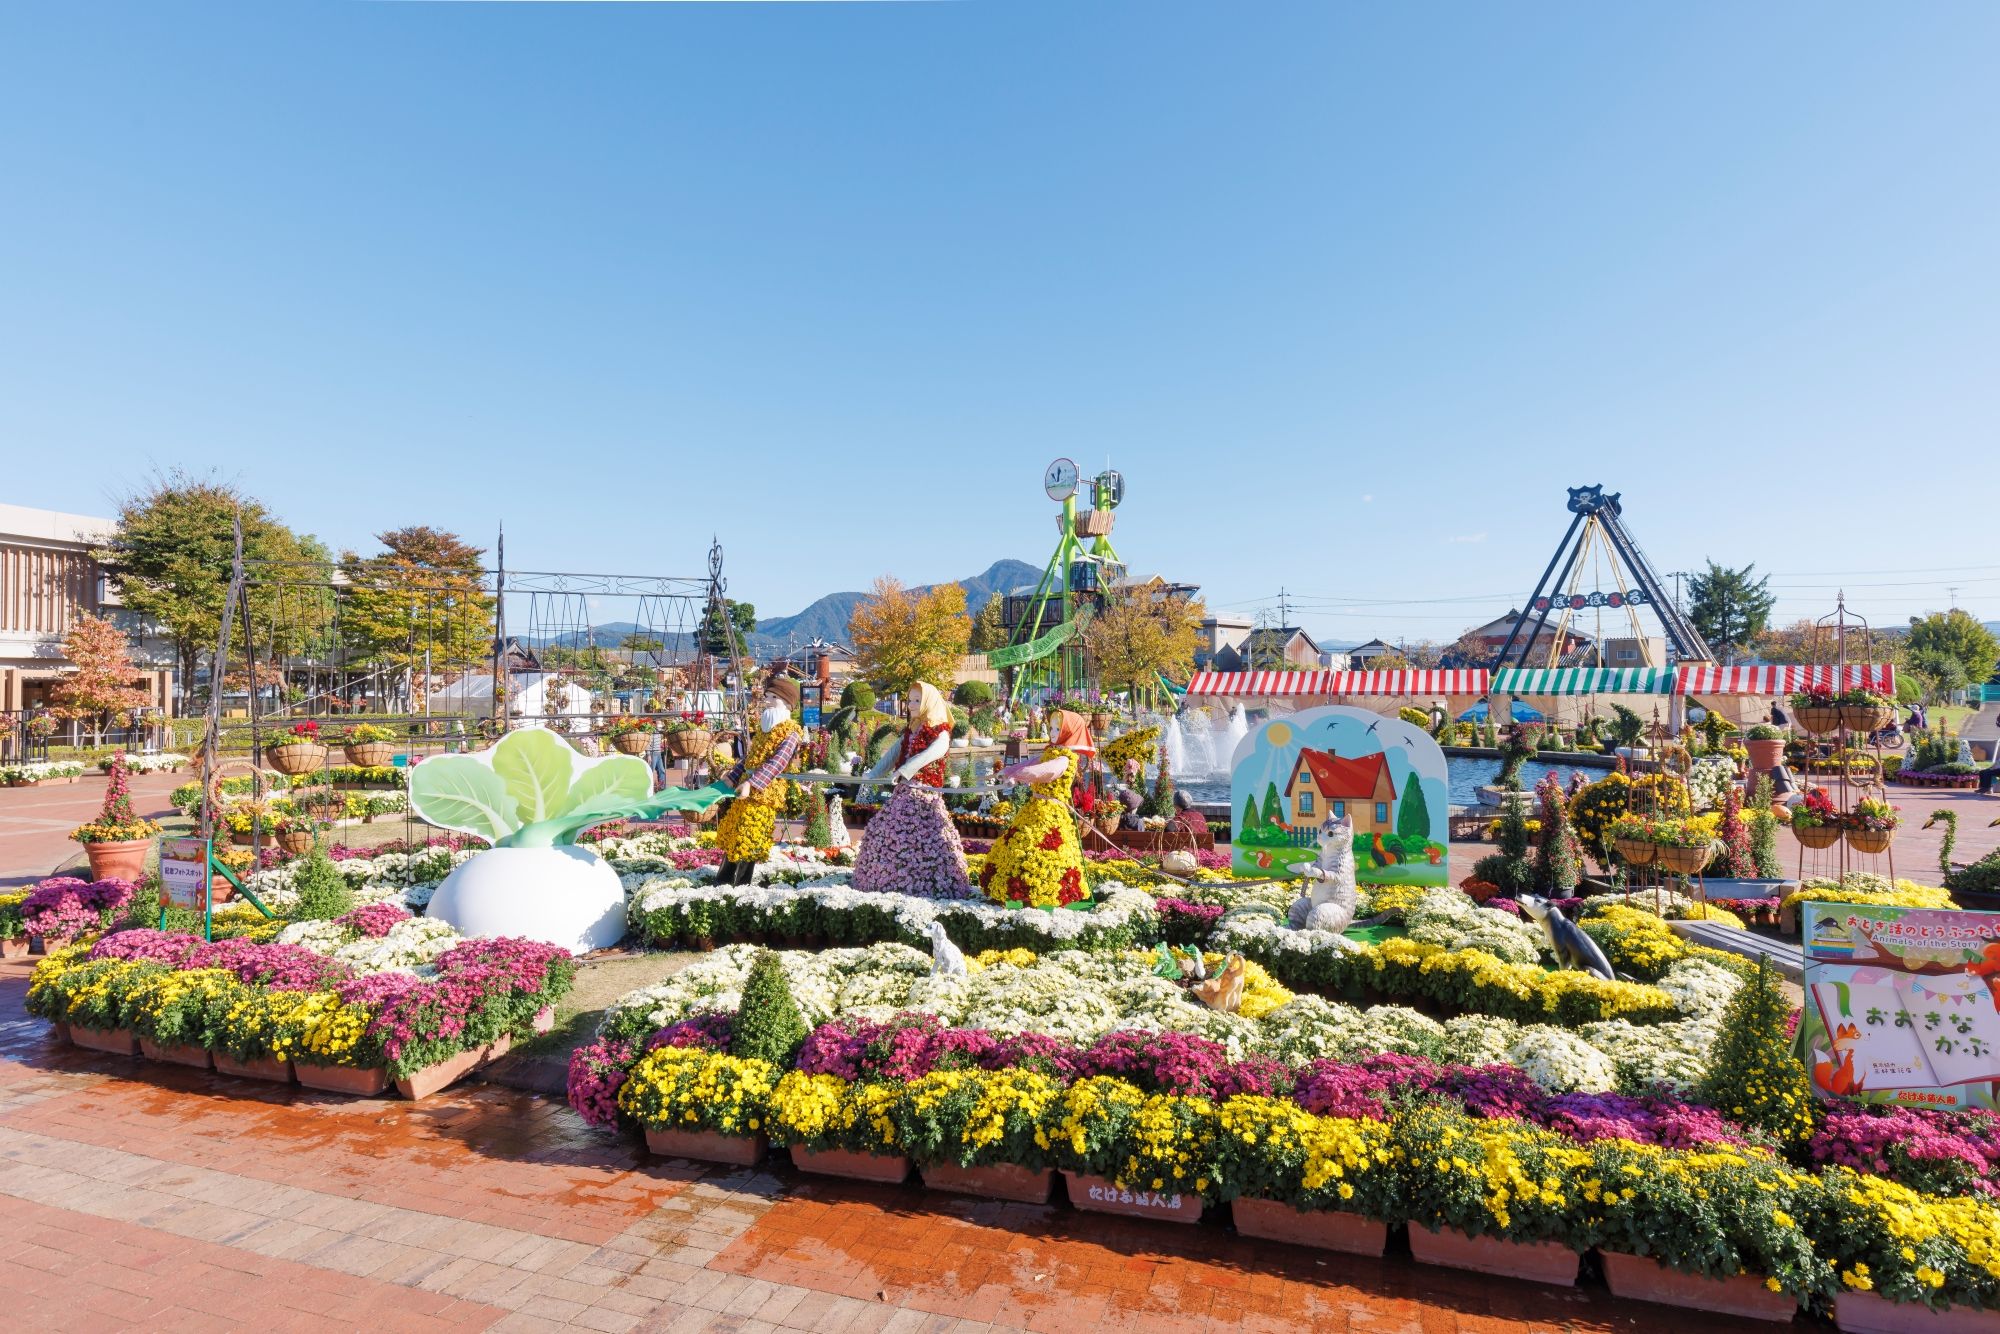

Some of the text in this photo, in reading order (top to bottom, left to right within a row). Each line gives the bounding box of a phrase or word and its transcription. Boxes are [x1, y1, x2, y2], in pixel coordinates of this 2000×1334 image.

[1872, 934, 1913, 946] Animals
[1930, 940, 1947, 948] the
[1950, 941, 1978, 949] Story
[1866, 1007, 1973, 1034] おおきな
[1935, 1036, 1989, 1058] かぶ
